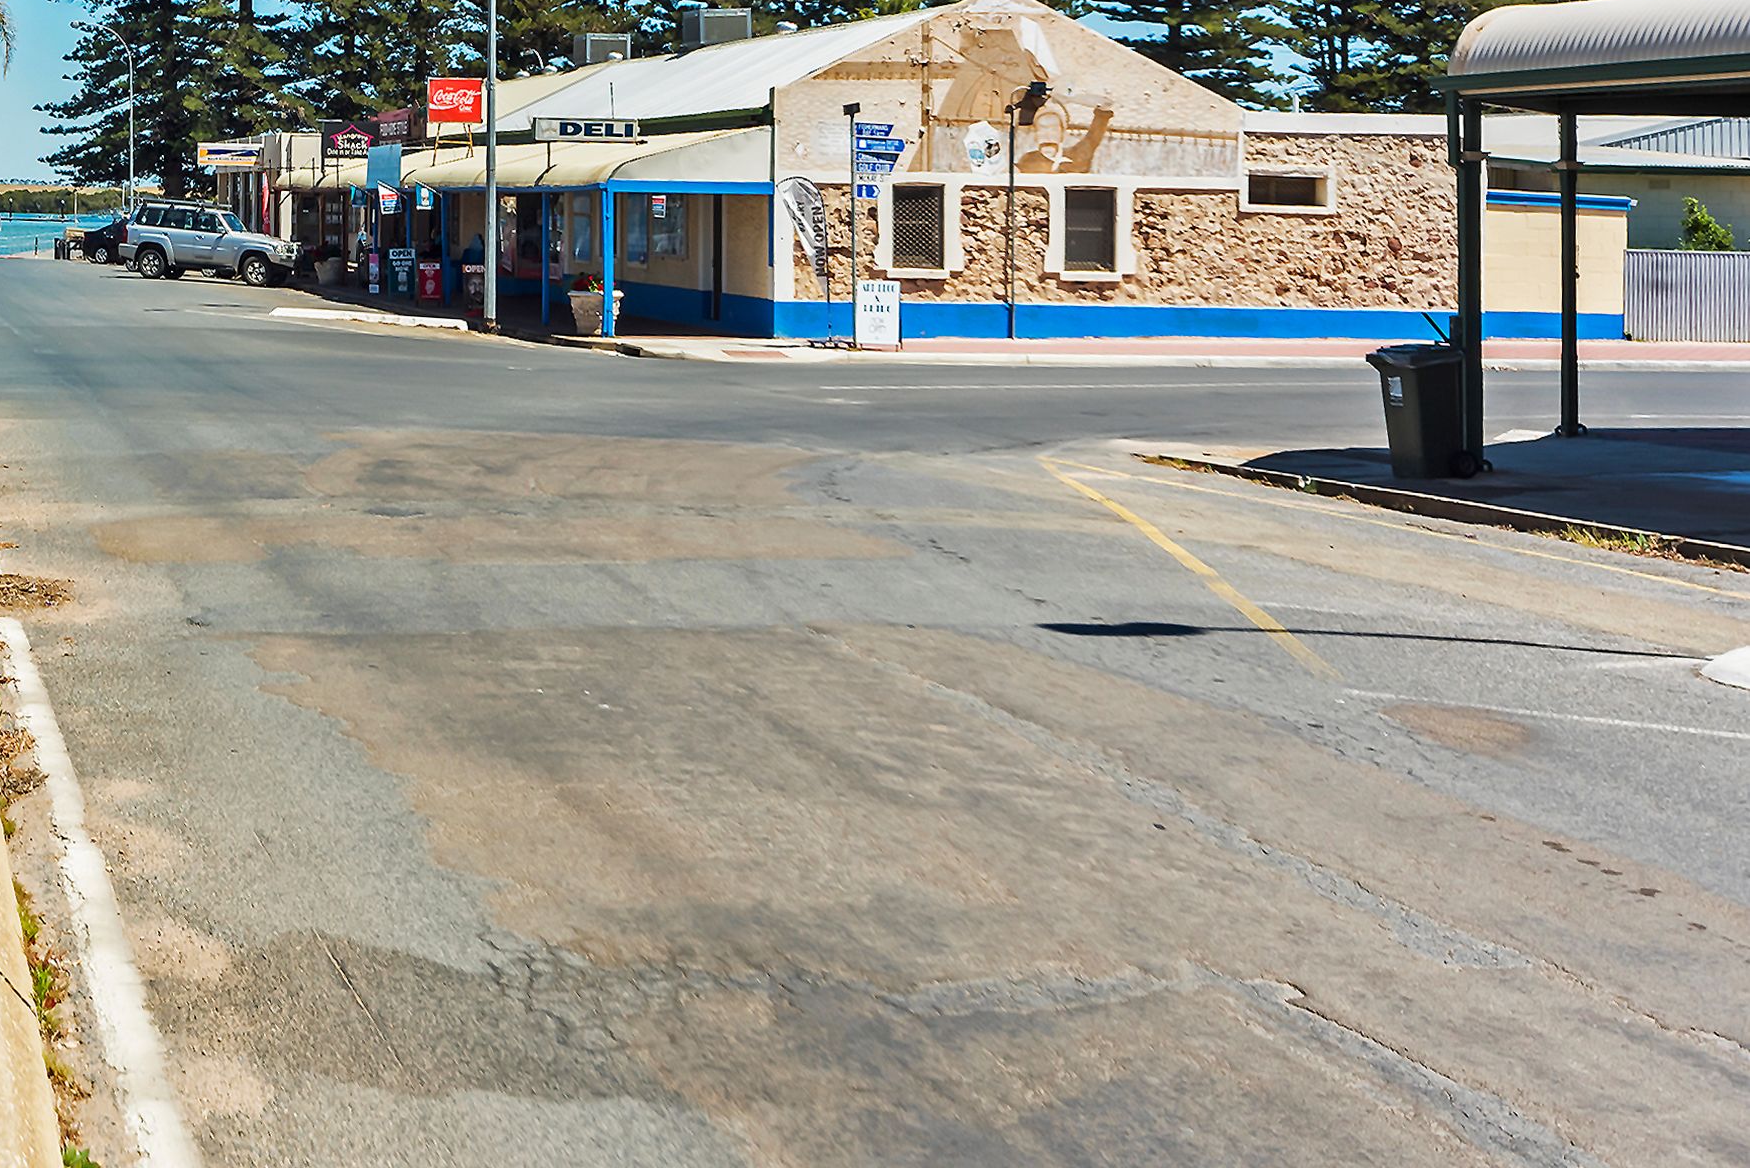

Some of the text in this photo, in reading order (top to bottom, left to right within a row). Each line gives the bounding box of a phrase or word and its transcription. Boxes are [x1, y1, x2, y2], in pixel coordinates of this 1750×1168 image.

[433, 89, 481, 106] Coca-Cola
[559, 121, 634, 138] DELI
[811, 205, 827, 278] NOW OPEN
[391, 249, 413, 258] OPEN
